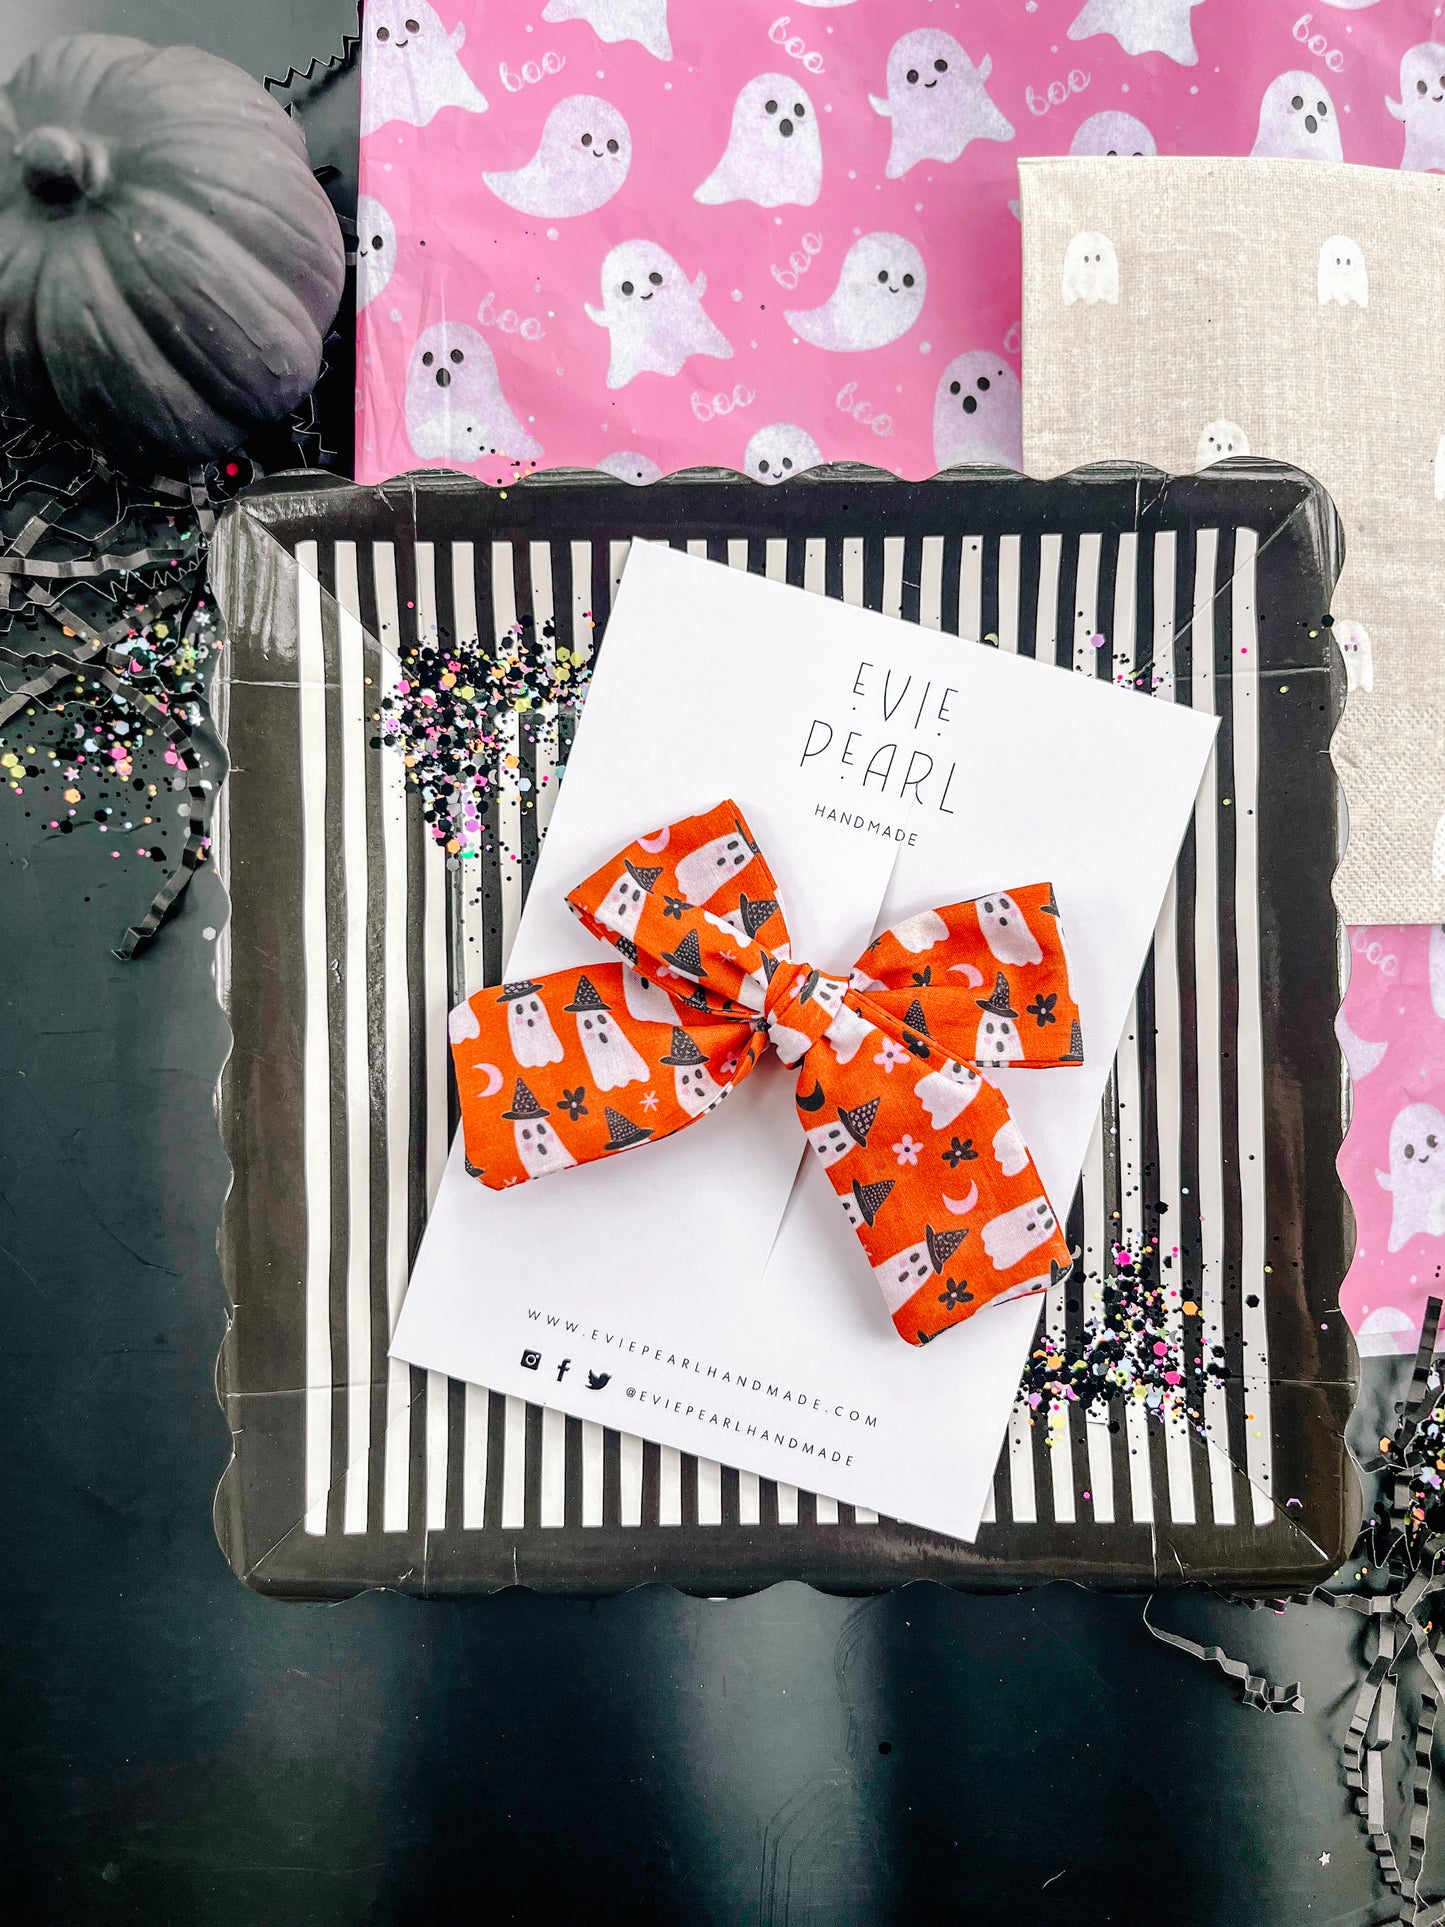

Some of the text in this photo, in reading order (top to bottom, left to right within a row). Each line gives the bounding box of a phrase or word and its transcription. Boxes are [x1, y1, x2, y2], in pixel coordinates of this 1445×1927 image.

[498, 52, 566, 93] boo
[768, 16, 826, 74] boo
[1292, 13, 1345, 73] boo
[1025, 68, 1091, 116] boo
[770, 231, 823, 290] boo
[690, 383, 757, 422] boo
[852, 661, 959, 736] EVIE
[800, 719, 957, 815] PEARL
[814, 803, 919, 847] HANDMADE
[527, 1308, 879, 1428] WWW.EVIEPEARLHANDMADE.COM
[625, 1386, 854, 1467] @EVIEPEARLHANDMADE
